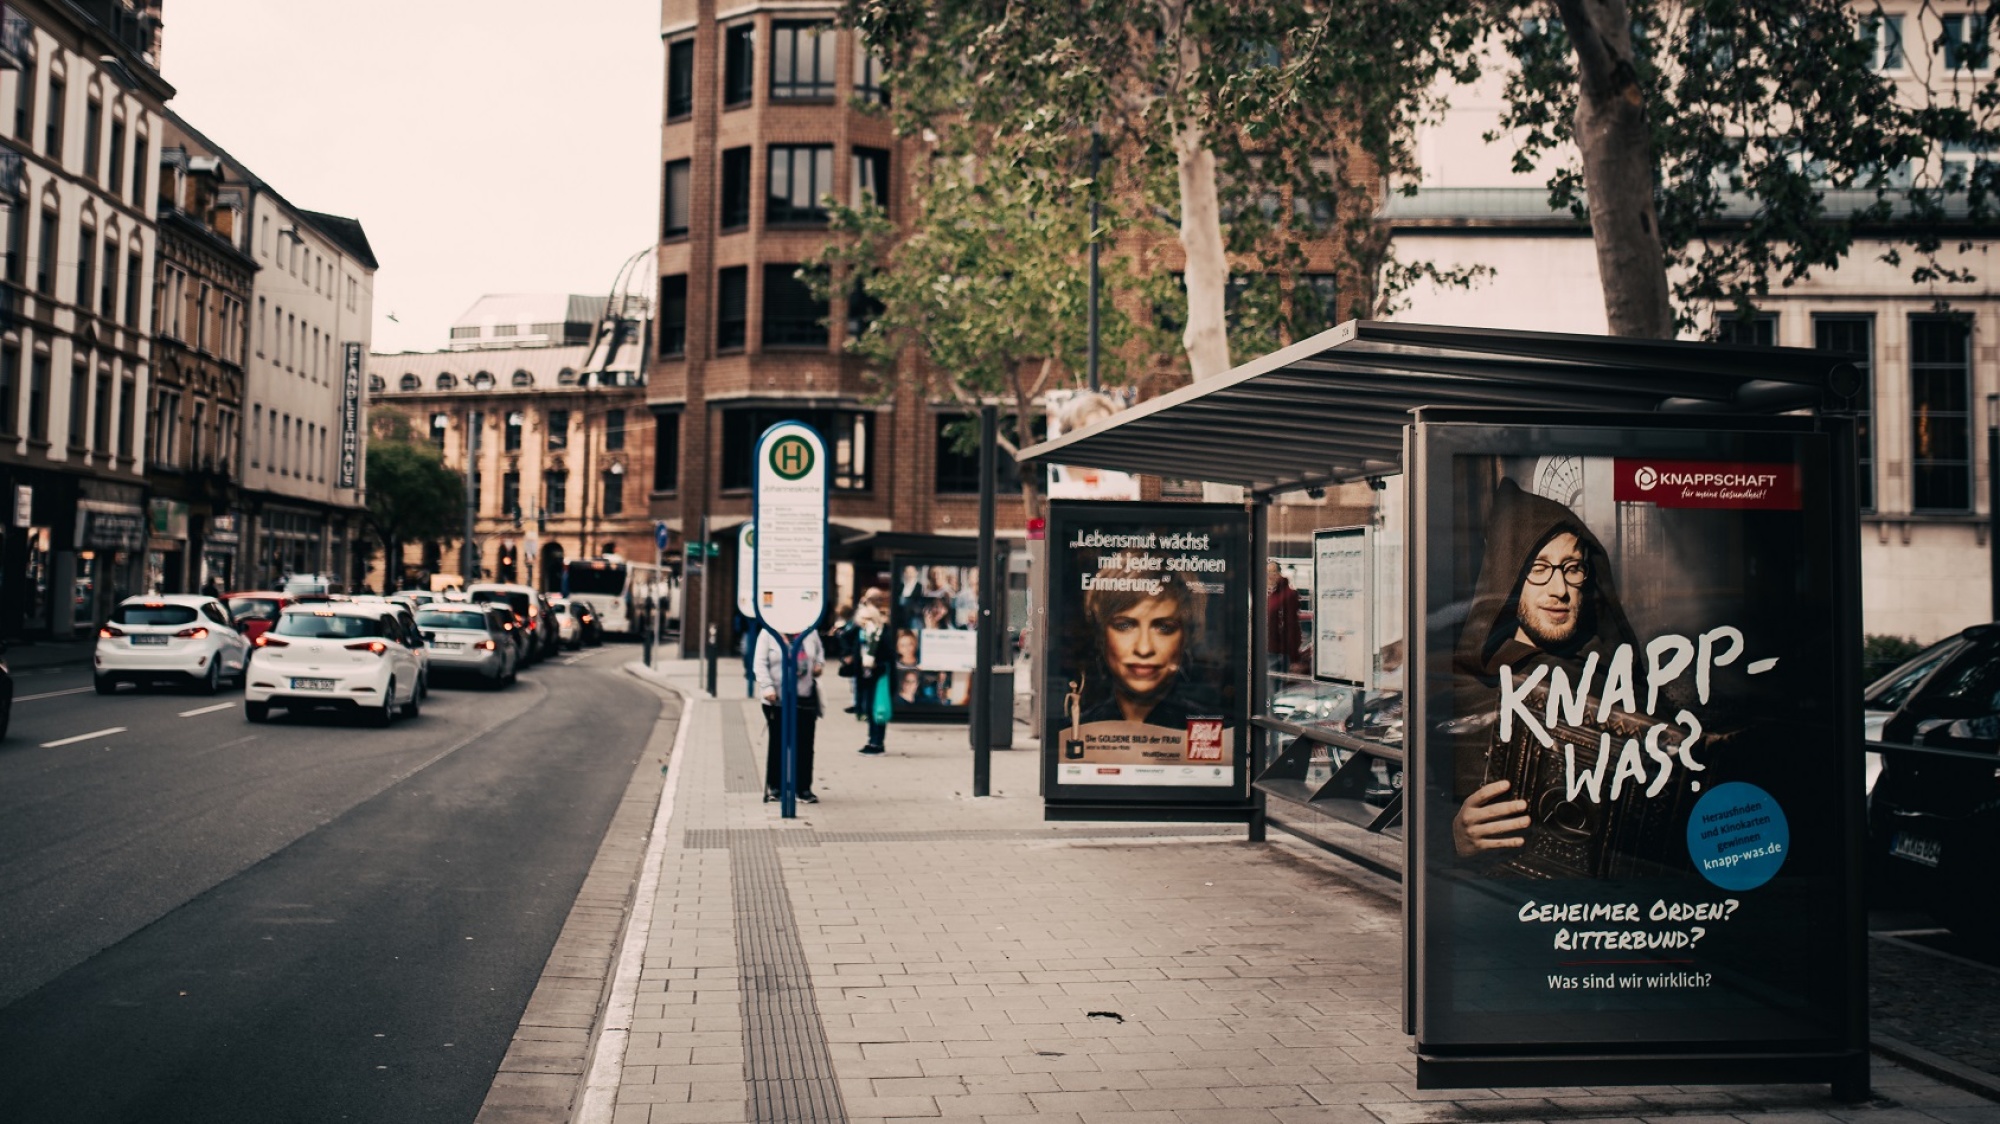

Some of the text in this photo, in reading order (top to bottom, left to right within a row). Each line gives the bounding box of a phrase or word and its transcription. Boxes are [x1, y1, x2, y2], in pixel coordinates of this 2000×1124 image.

[782, 445, 802, 470] H
[1660, 473, 1777, 487] KNAPPSCHAFT
[1681, 487, 1767, 500] für meine Gesundheit!
[1159, 531, 1210, 550] wächst
[1097, 552, 1226, 573] mit jeder schönen
[1500, 625, 1780, 748] KNAPP-
[1085, 735, 1181, 745] Die GOLDENE BILD der FRAU
[1564, 709, 1706, 804] WAS?
[1702, 802, 1762, 824] Herausfinden
[1701, 815, 1771, 839] und Kinokarten
[1717, 833, 1761, 853] gewinnen
[1704, 842, 1782, 870] knapp-was.de
[1518, 899, 1739, 922] GEHEIMER ORDEN?
[1554, 926, 1706, 950] RITTERBUND?
[1547, 972, 1712, 989] Was sind wir wirklich?
